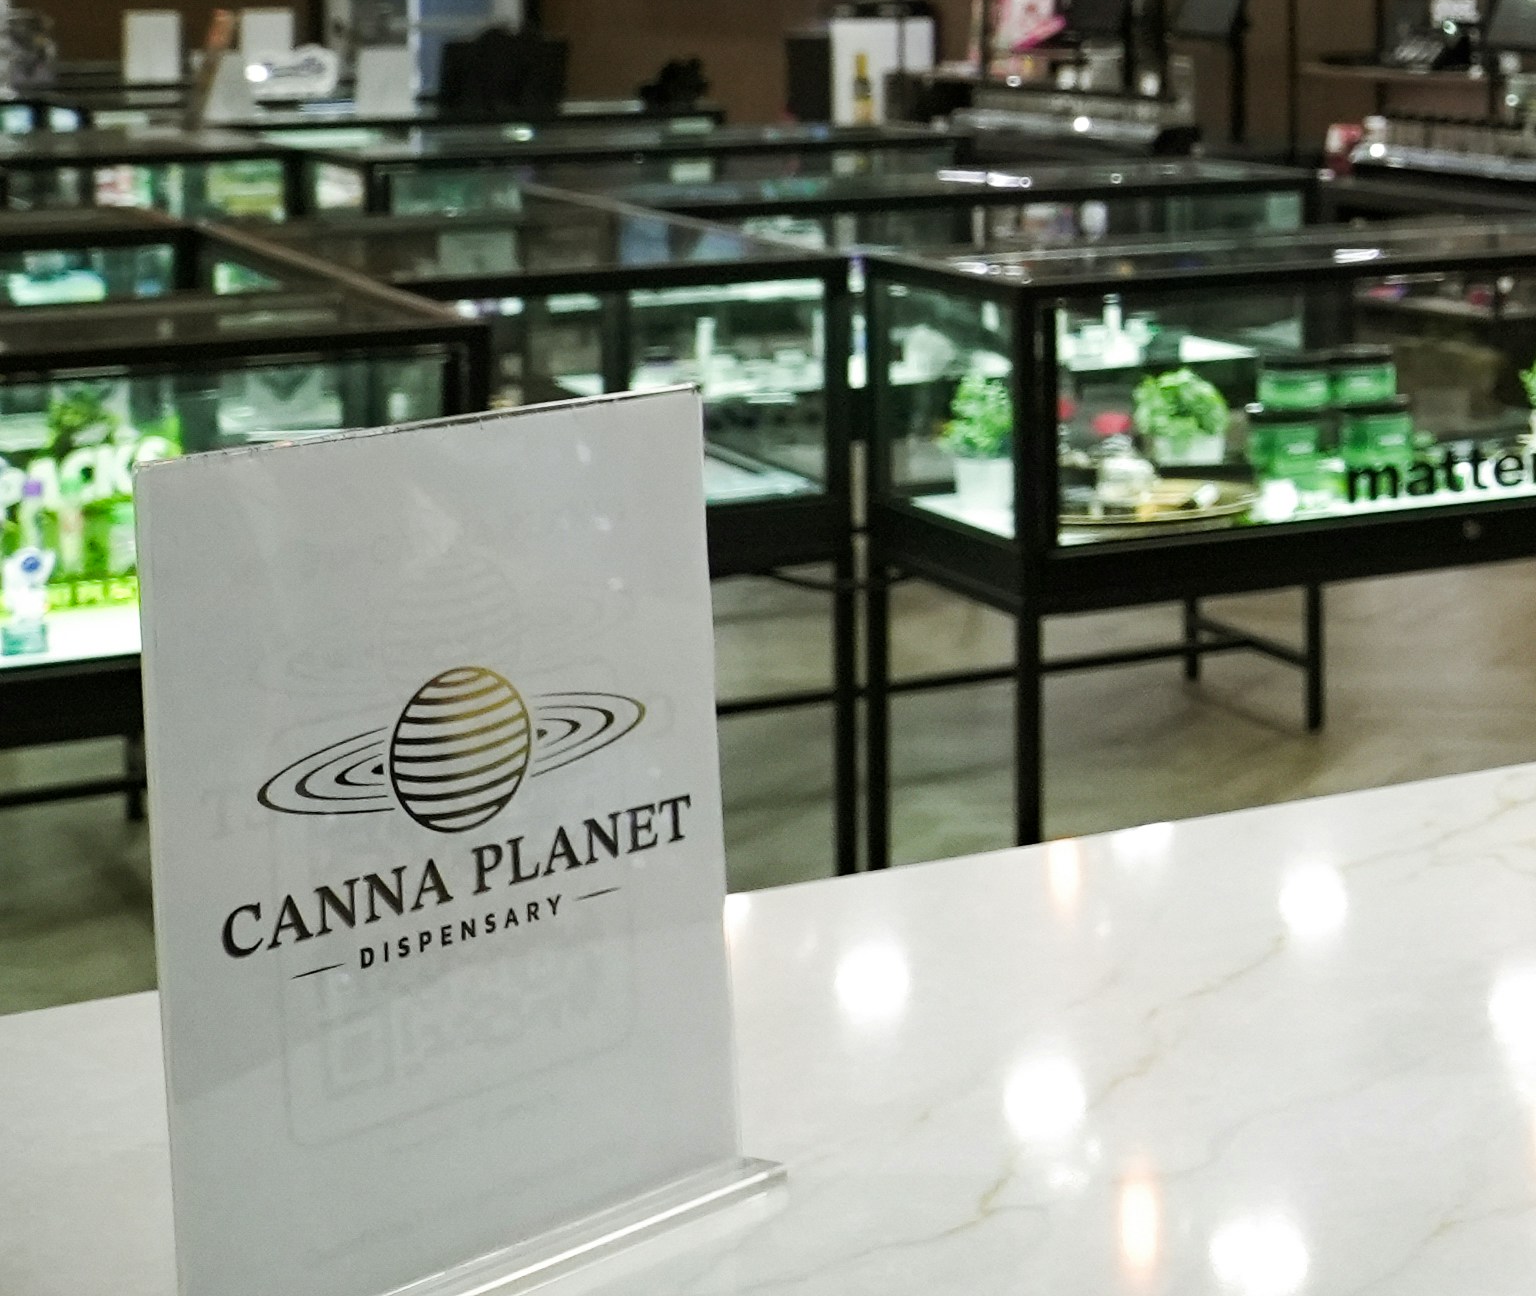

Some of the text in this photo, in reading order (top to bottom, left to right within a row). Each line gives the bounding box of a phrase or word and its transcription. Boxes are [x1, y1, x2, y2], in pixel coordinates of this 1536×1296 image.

[221, 794, 692, 960] CANNA PLANET
[359, 894, 562, 970] DISPENSARY
